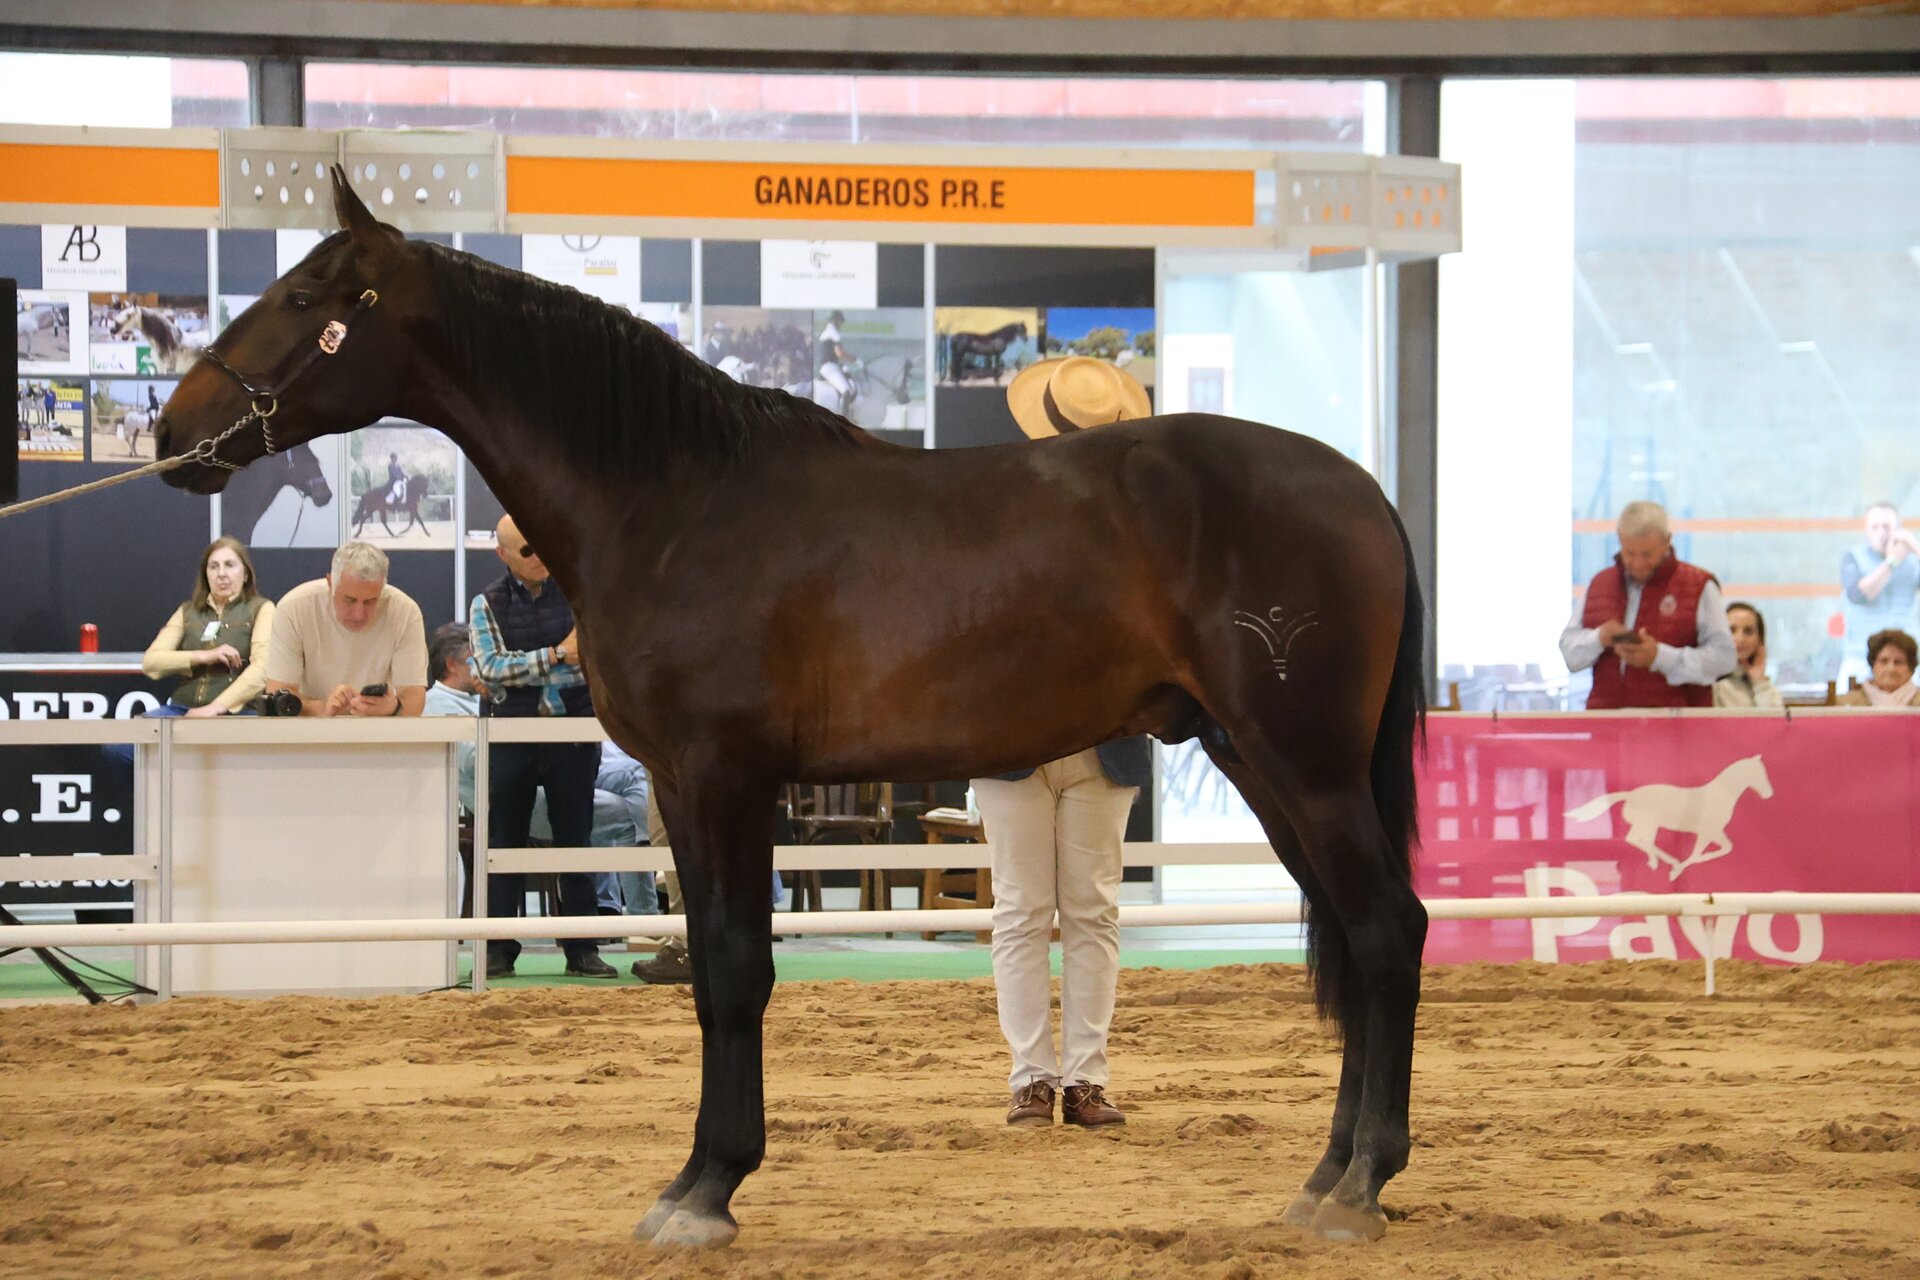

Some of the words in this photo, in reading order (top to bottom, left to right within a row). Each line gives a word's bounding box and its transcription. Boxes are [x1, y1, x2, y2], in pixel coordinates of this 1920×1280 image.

[754, 174, 930, 208] GANADEROS
[941, 179, 1006, 209] P.R.E
[1523, 867, 1825, 964] Pavo
